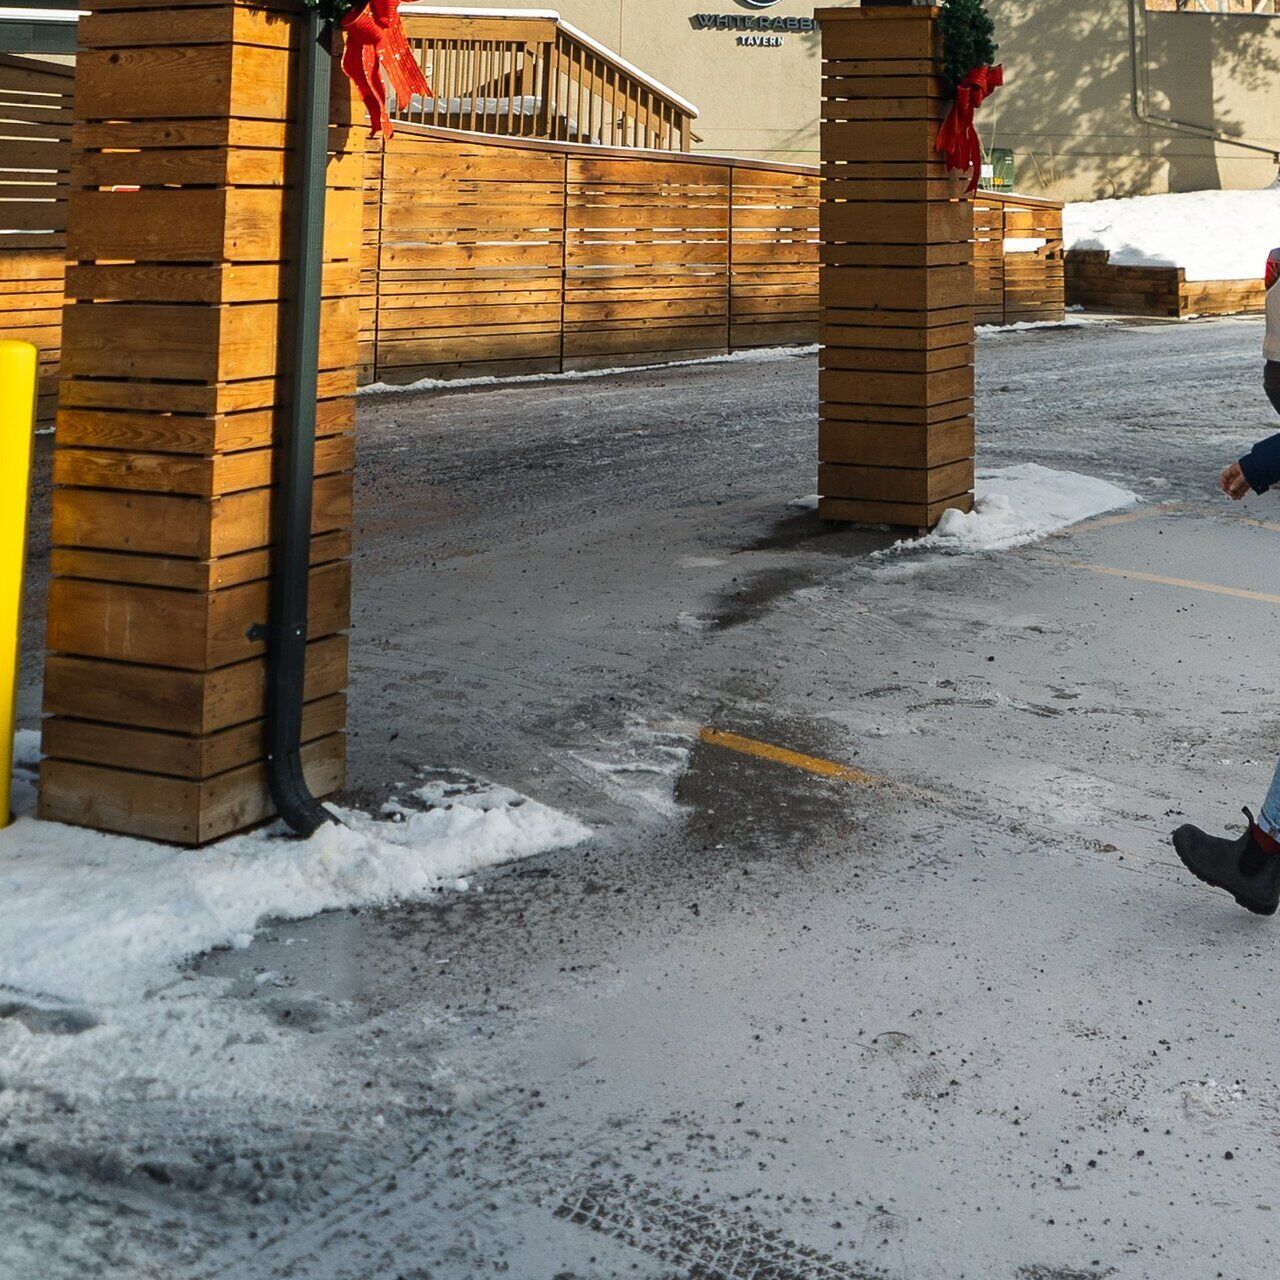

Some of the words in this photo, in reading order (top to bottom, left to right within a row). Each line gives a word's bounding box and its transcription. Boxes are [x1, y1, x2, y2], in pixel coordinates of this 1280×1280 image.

[695, 14, 755, 29] WHITE
[759, 16, 818, 30] RABBI
[740, 35, 785, 47] TAVERN
